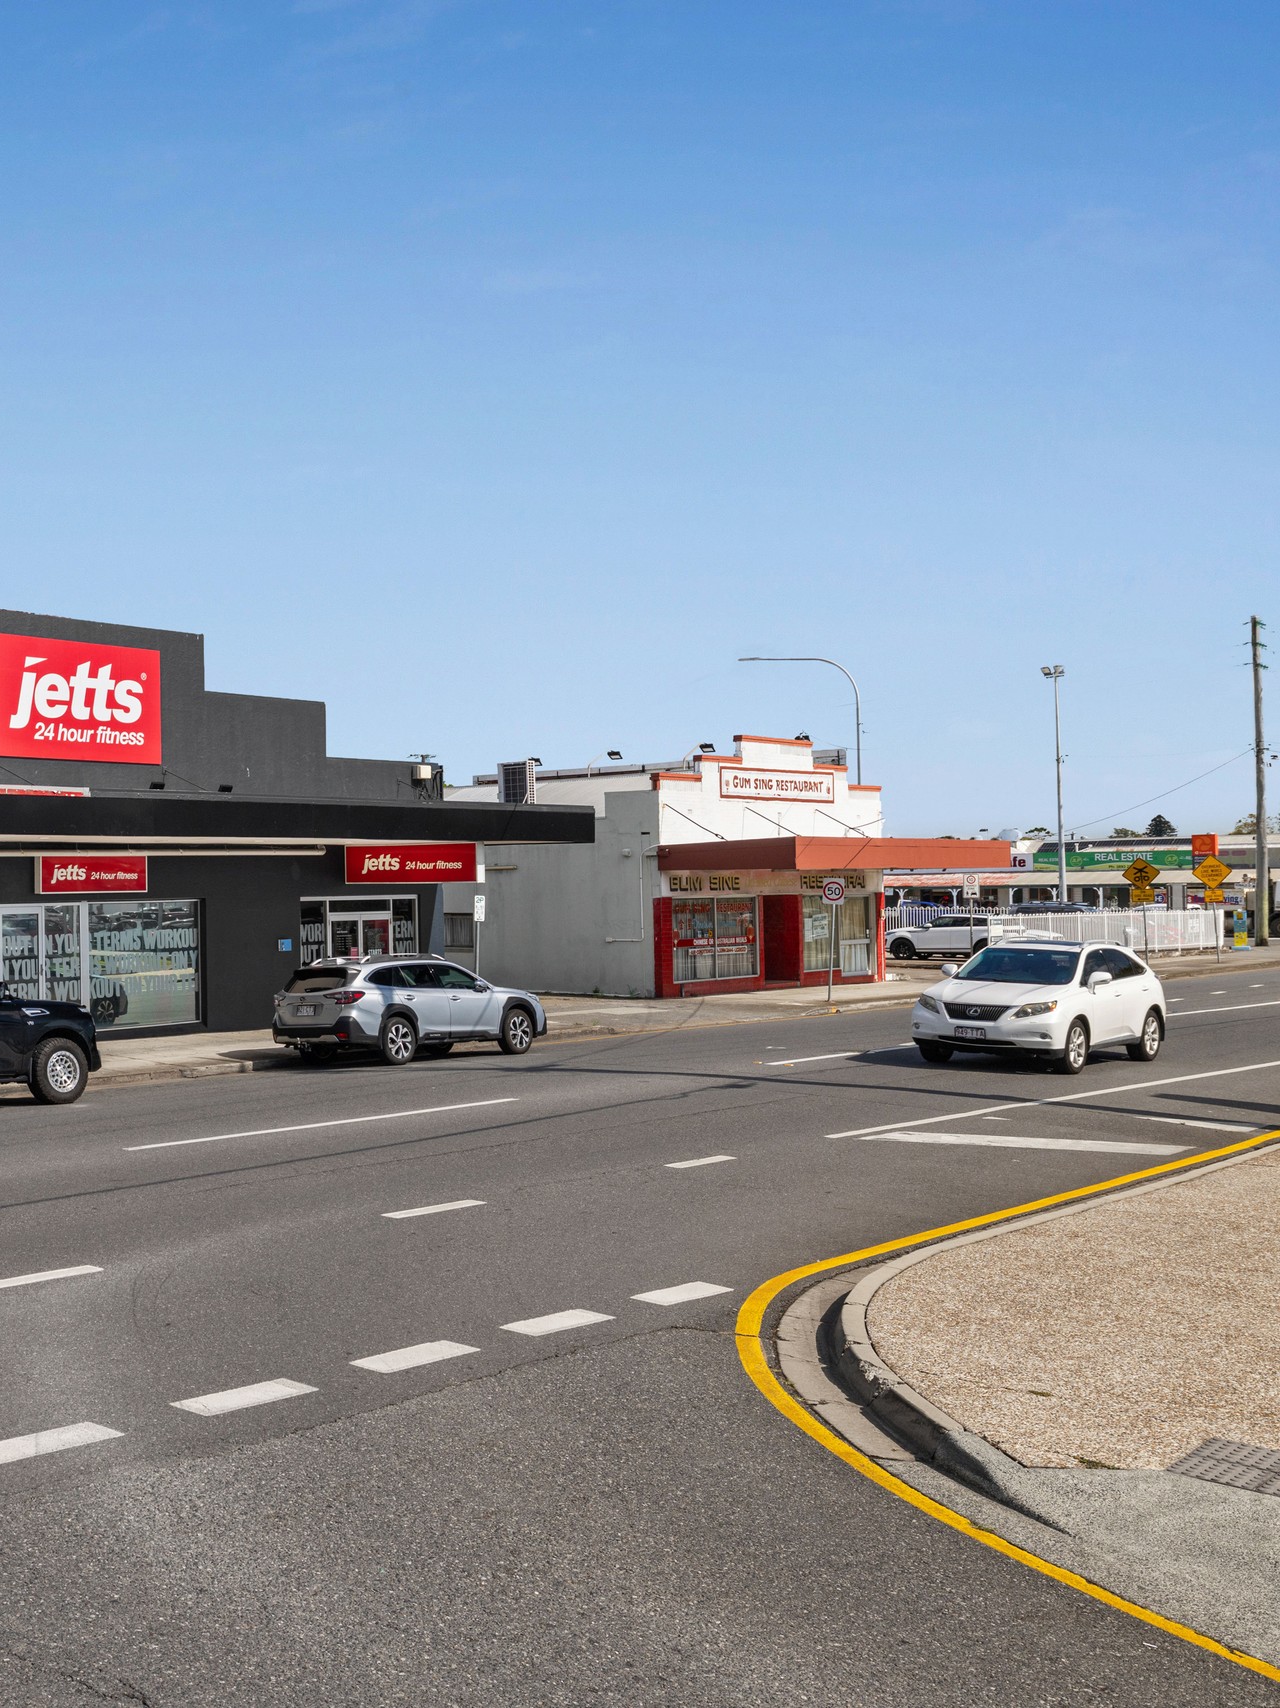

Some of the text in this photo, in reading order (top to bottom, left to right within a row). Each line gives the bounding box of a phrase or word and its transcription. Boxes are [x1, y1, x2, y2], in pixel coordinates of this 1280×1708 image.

[9, 656, 144, 729] jetts
[33, 722, 145, 746] 24 hour fitness
[732, 775, 823, 793] GUM SING RESTAURANT
[361, 854, 462, 875] jetts 24 hour fitness
[1011, 856, 1026, 868] fe
[1094, 852, 1153, 861] REAL ESTATE
[50, 864, 138, 884] jetts 24 hour fitness
[827, 887, 841, 896] 50
